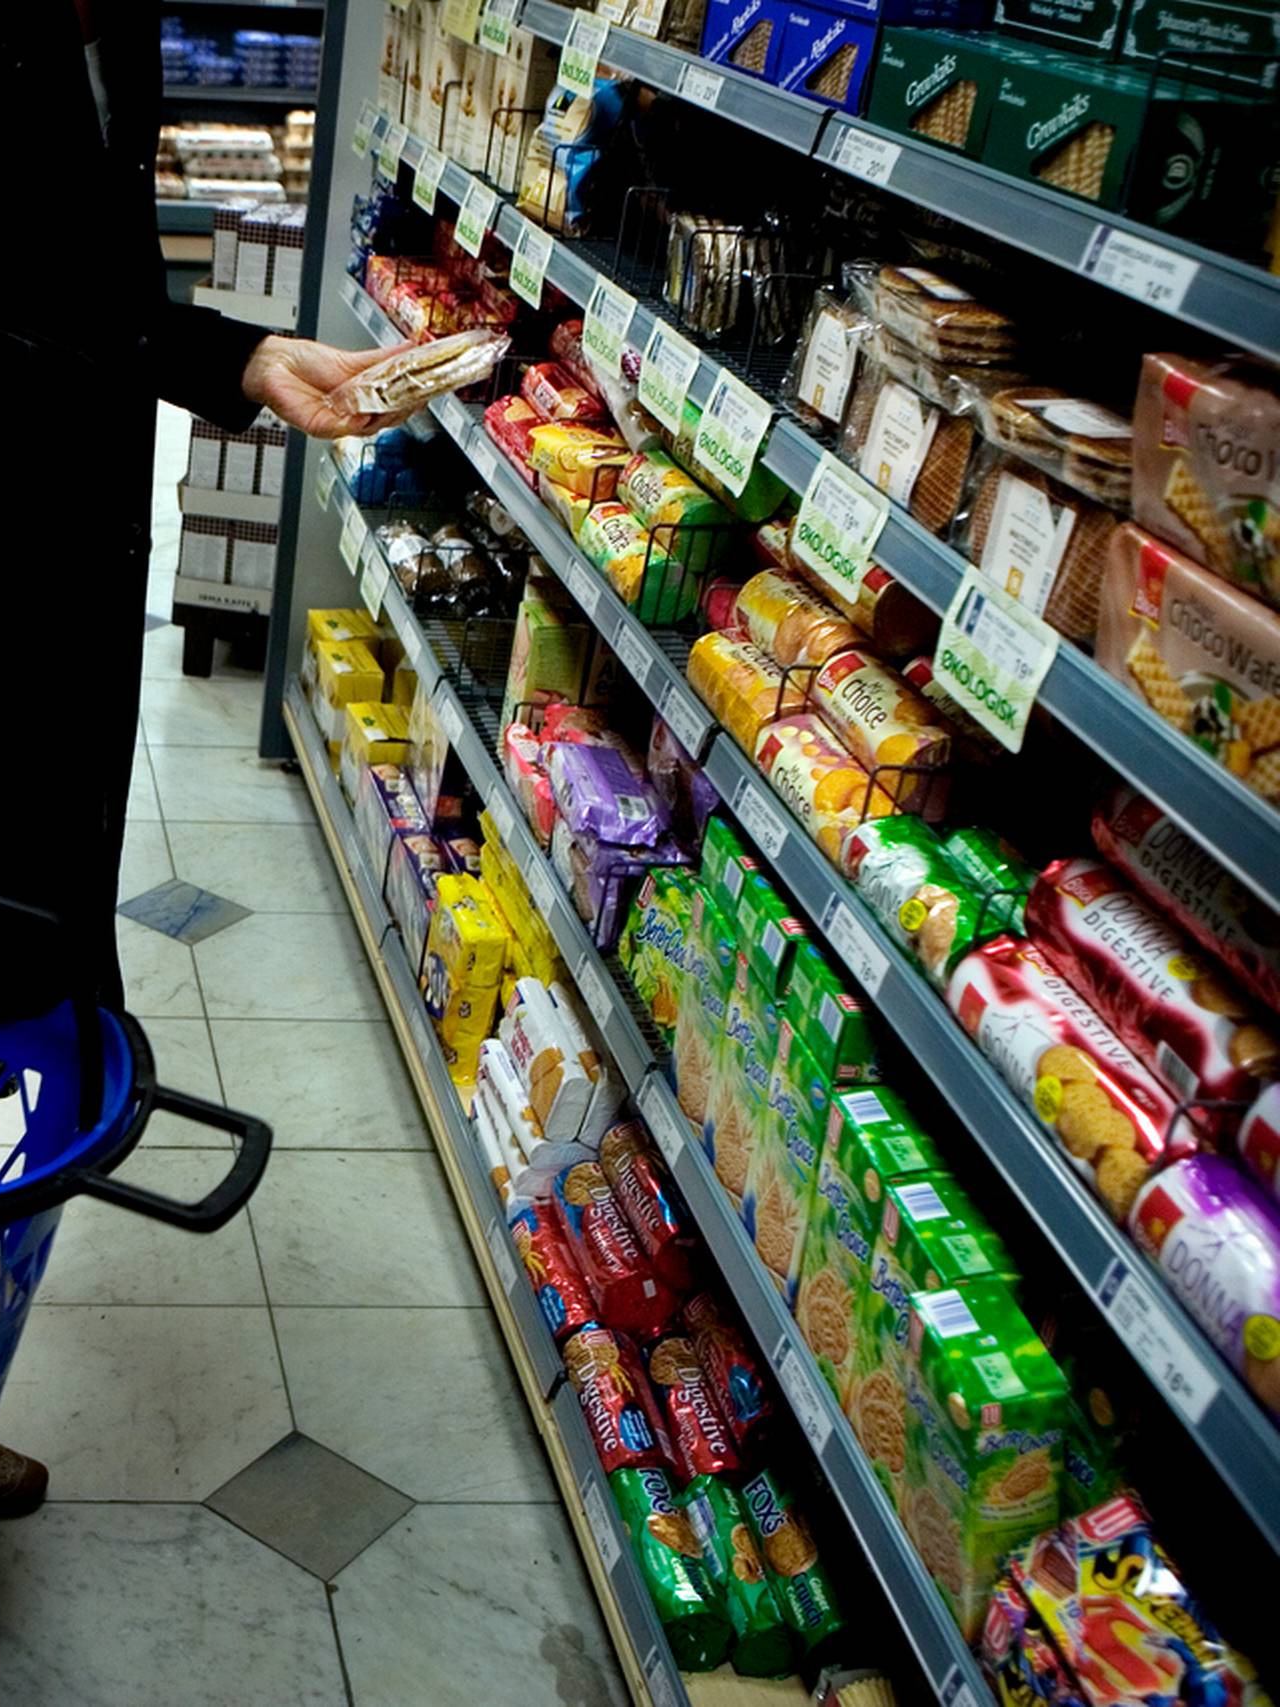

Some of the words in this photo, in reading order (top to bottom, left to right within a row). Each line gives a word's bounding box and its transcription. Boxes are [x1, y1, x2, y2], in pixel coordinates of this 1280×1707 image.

[700, 431, 745, 483] ØKOLOGISK
[799, 523, 858, 584] ØKOLOGISK
[842, 678, 888, 730] Choice
[941, 649, 1018, 731] ØKOLOGISK
[775, 767, 812, 822] Choice
[1101, 894, 1168, 962] DONNA
[1140, 850, 1236, 942] DIGESTIVE
[1083, 911, 1175, 1001] DIGESTIVE
[1044, 978, 1134, 1070] DIGESTIVE
[589, 1185, 638, 1260] Digestive
[614, 1152, 661, 1230] Digestive
[577, 1360, 618, 1453] Digestive
[677, 1366, 727, 1454] Digestive
[1086, 1498, 1139, 1537] LU
[791, 1572, 825, 1628] Crunch
